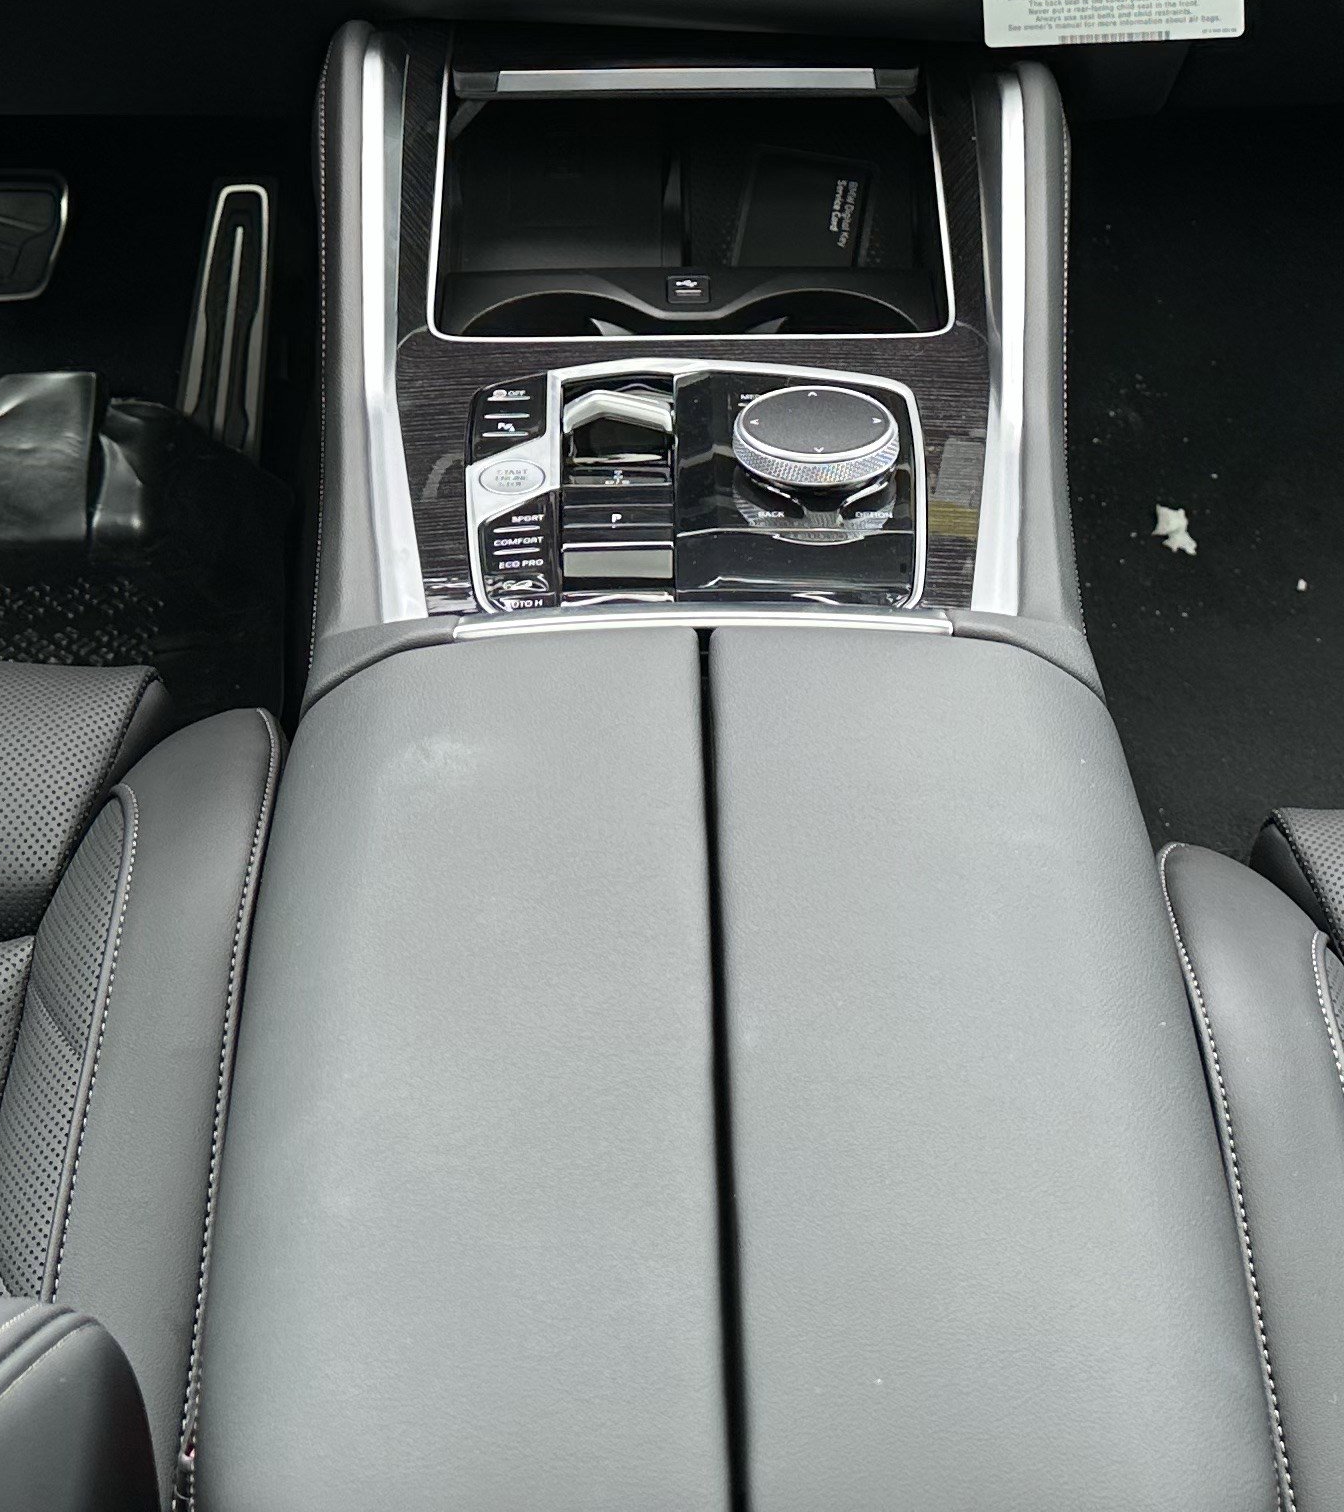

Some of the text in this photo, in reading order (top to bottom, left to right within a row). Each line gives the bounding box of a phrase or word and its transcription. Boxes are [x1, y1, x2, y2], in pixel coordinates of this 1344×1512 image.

[511, 514, 545, 523] SPORT
[611, 513, 622, 523] P
[493, 536, 544, 546] COMFORT
[499, 558, 544, 569] ECO PRO
